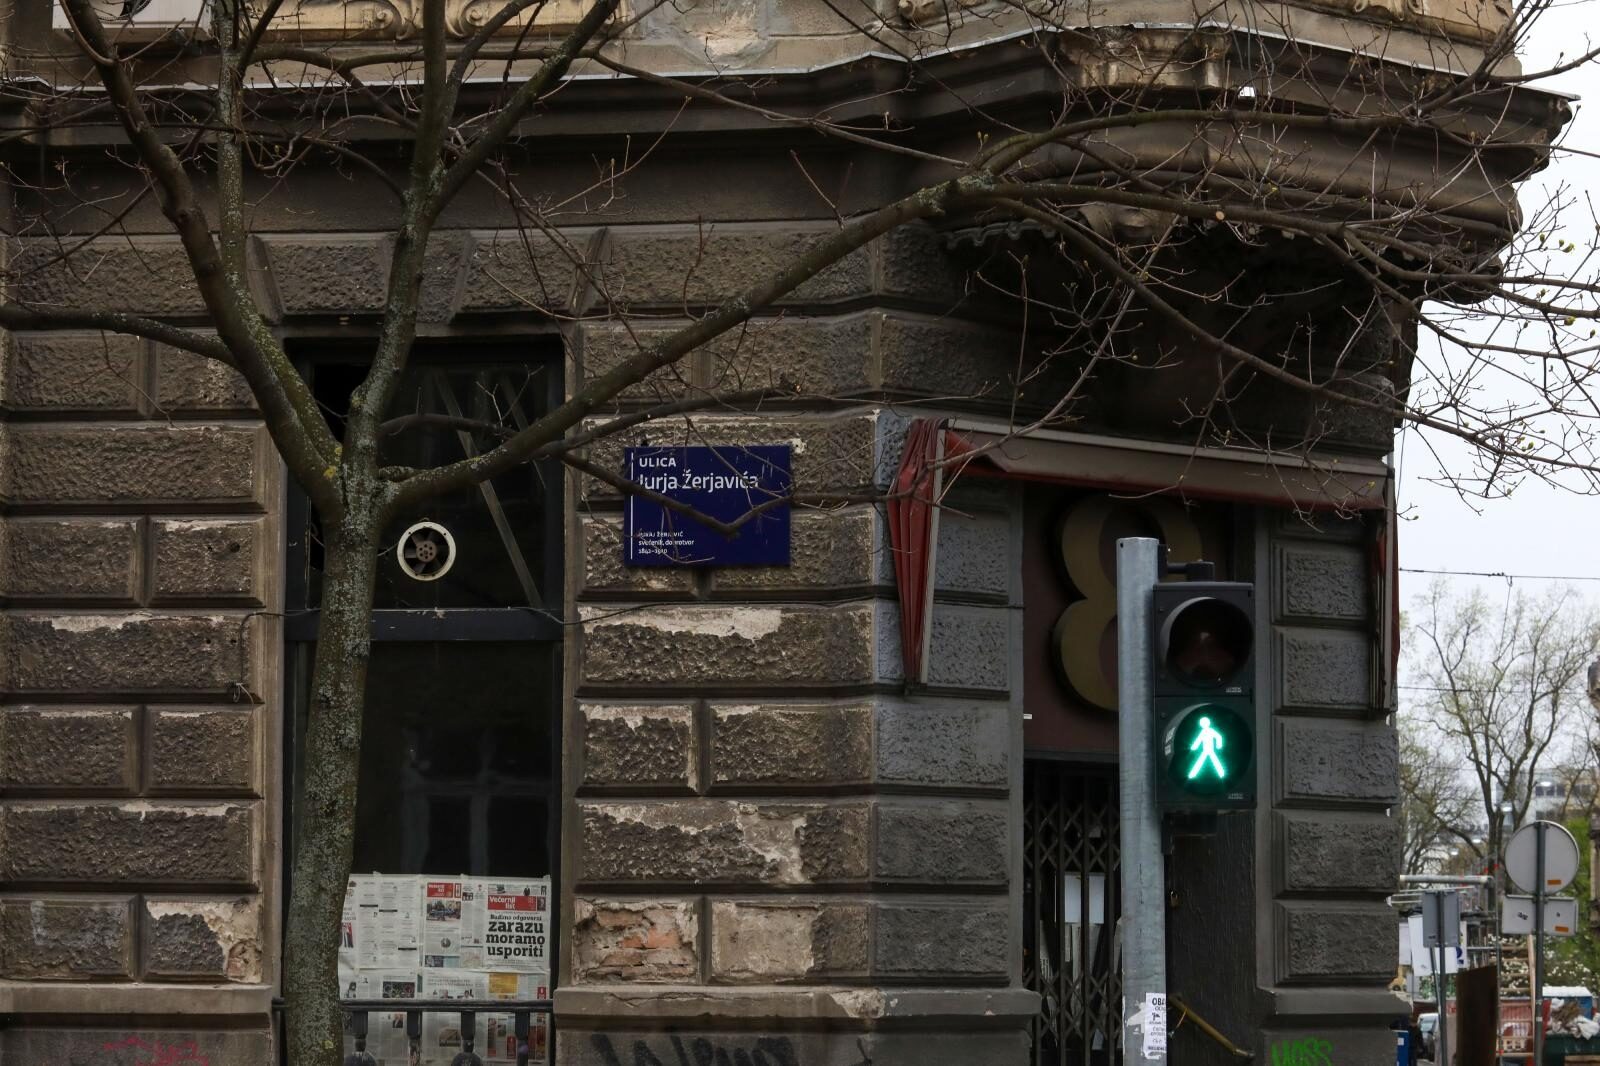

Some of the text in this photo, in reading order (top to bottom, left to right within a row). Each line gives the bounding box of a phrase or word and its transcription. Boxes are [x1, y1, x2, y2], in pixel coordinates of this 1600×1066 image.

[639, 457, 677, 467] ULICA
[682, 469, 759, 493] Žerjavića
[487, 921, 544, 933] zarazu
[485, 934, 546, 945] moramo
[487, 945, 543, 959] usporiti
